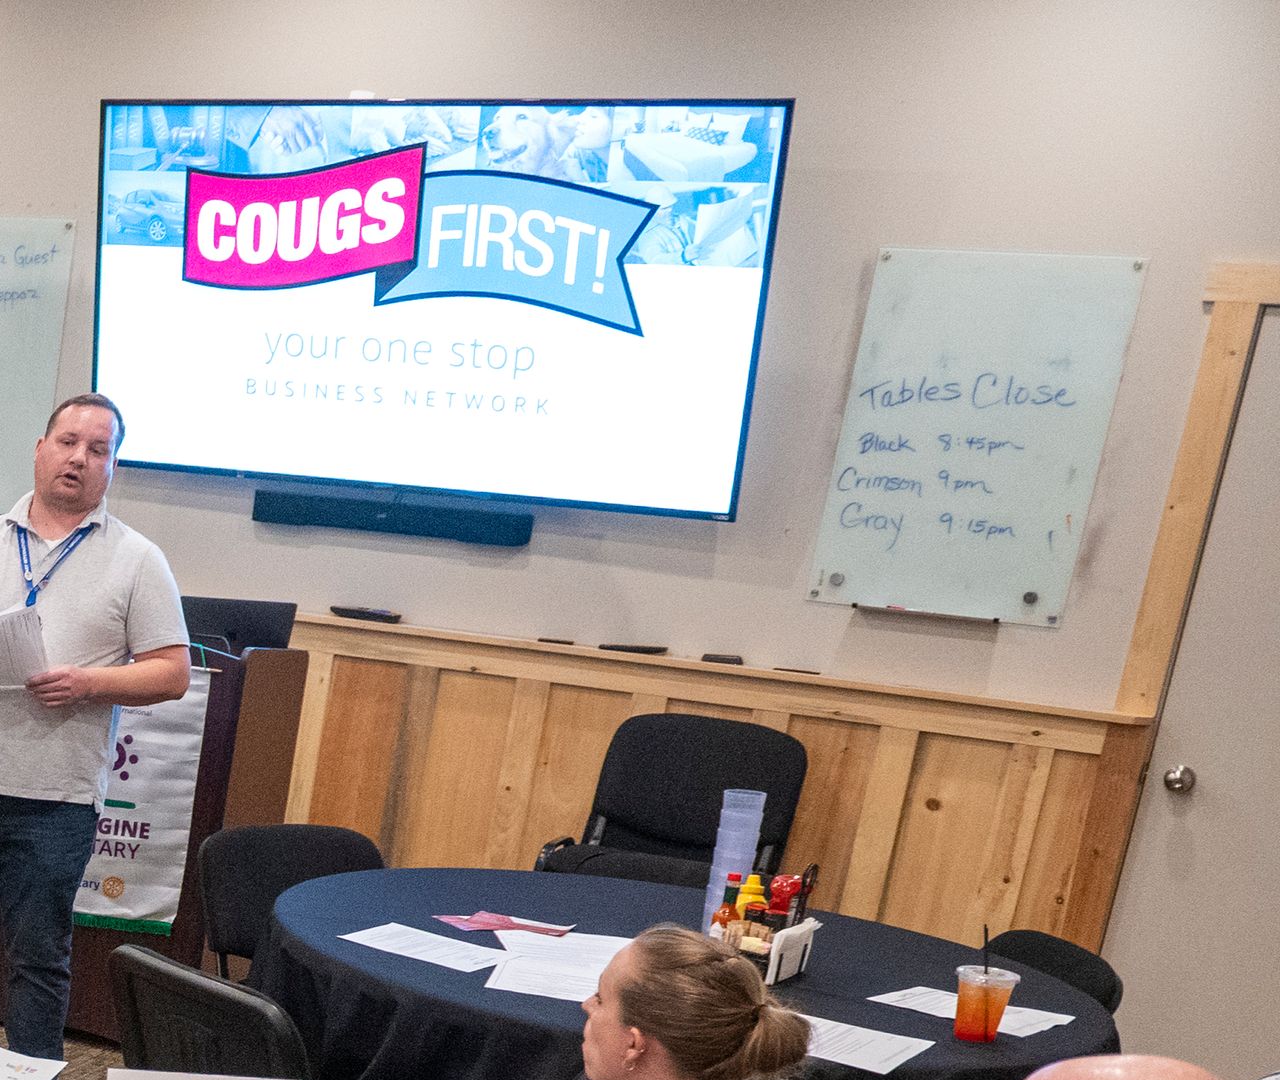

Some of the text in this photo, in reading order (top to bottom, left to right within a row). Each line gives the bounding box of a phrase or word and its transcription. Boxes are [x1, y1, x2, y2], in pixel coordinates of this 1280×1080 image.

[197, 178, 610, 294] COUGS FIRST!
[14, 244, 60, 268] Guest
[263, 332, 536, 380] your one stop
[245, 377, 549, 416] BUSINESS NETWORK
[859, 372, 1078, 411] Tables Close
[859, 431, 917, 455] Black
[837, 466, 923, 498] Crimson
[840, 502, 904, 551] Gray
[121, 706, 153, 717] rnational
[97, 817, 151, 839] GINE
[92, 839, 141, 860] TARY
